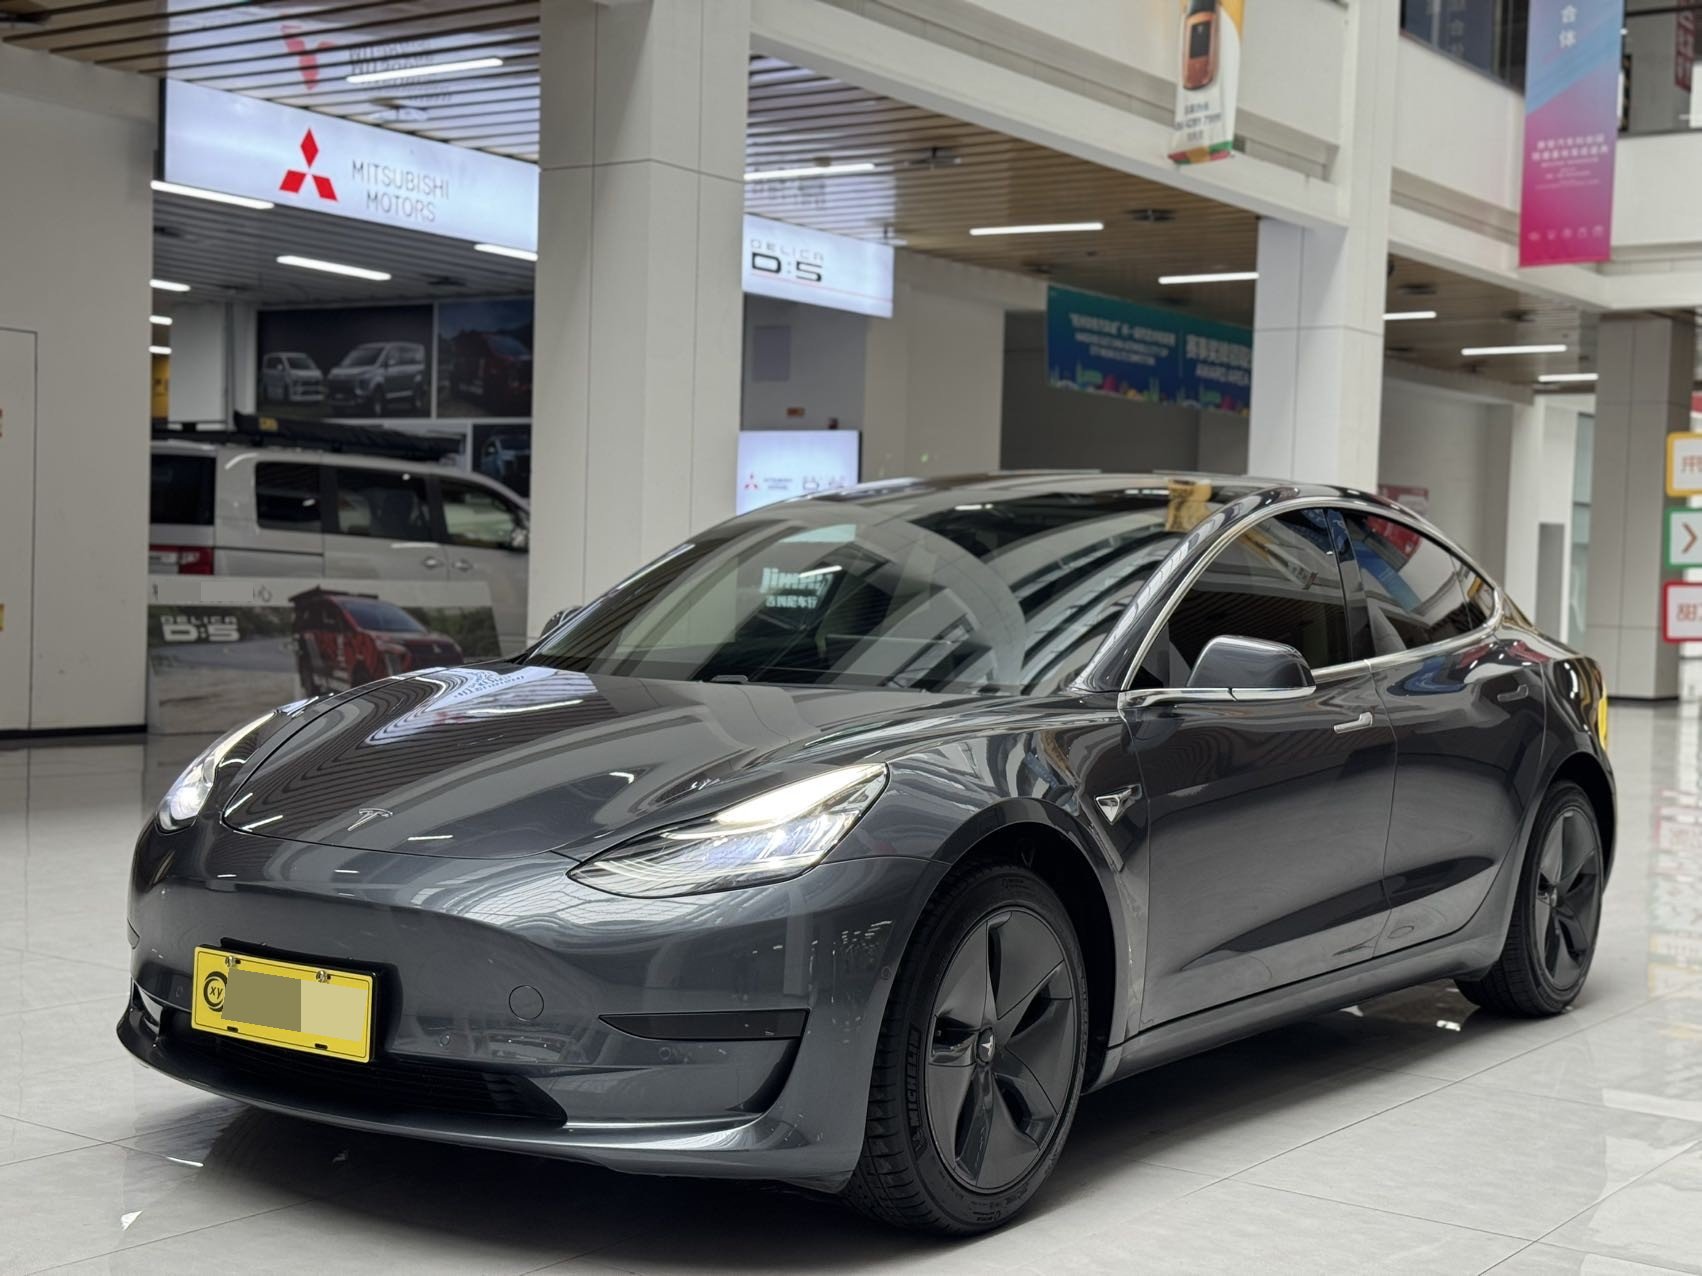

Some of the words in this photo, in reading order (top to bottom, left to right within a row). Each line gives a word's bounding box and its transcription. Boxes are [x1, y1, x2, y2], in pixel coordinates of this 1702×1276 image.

[352, 159, 450, 200] MITSUBISHI
[366, 190, 436, 222] MOTORS
[751, 239, 824, 262] DELICA
[906, 1026, 920, 1128] MICHELIN
